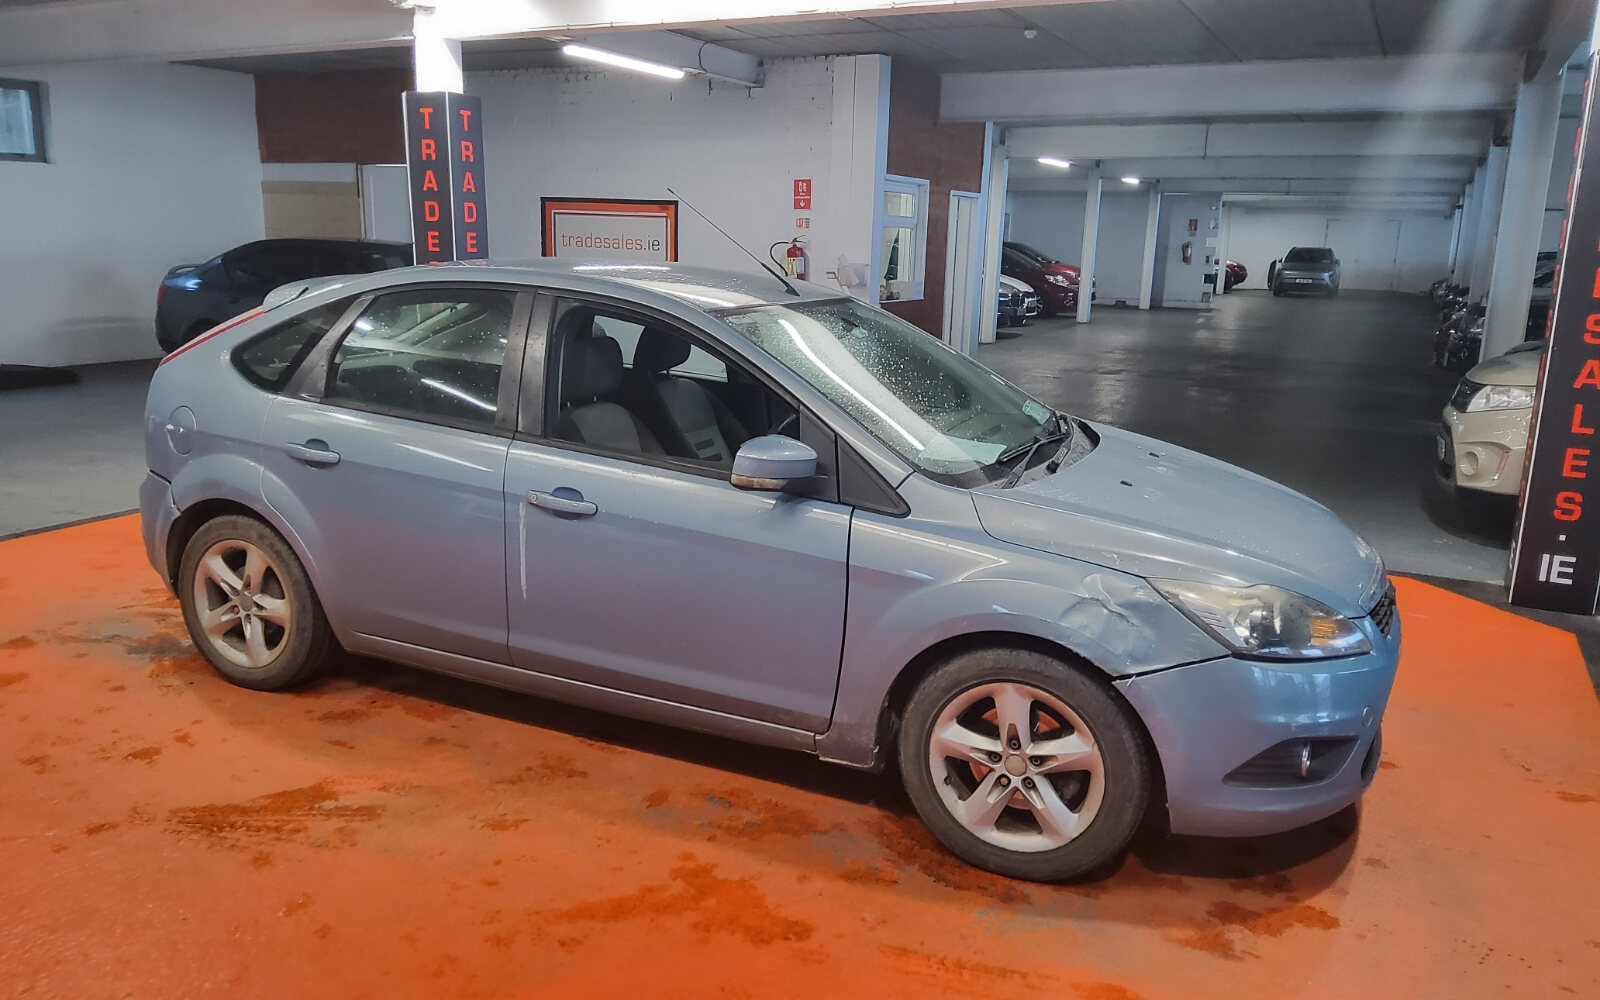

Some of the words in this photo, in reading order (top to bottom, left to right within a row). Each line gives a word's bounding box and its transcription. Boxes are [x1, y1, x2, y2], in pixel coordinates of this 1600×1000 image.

[419, 107, 440, 264] TRADE
[459, 109, 478, 253] TRADE
[561, 232, 660, 251] tradesales.ie
